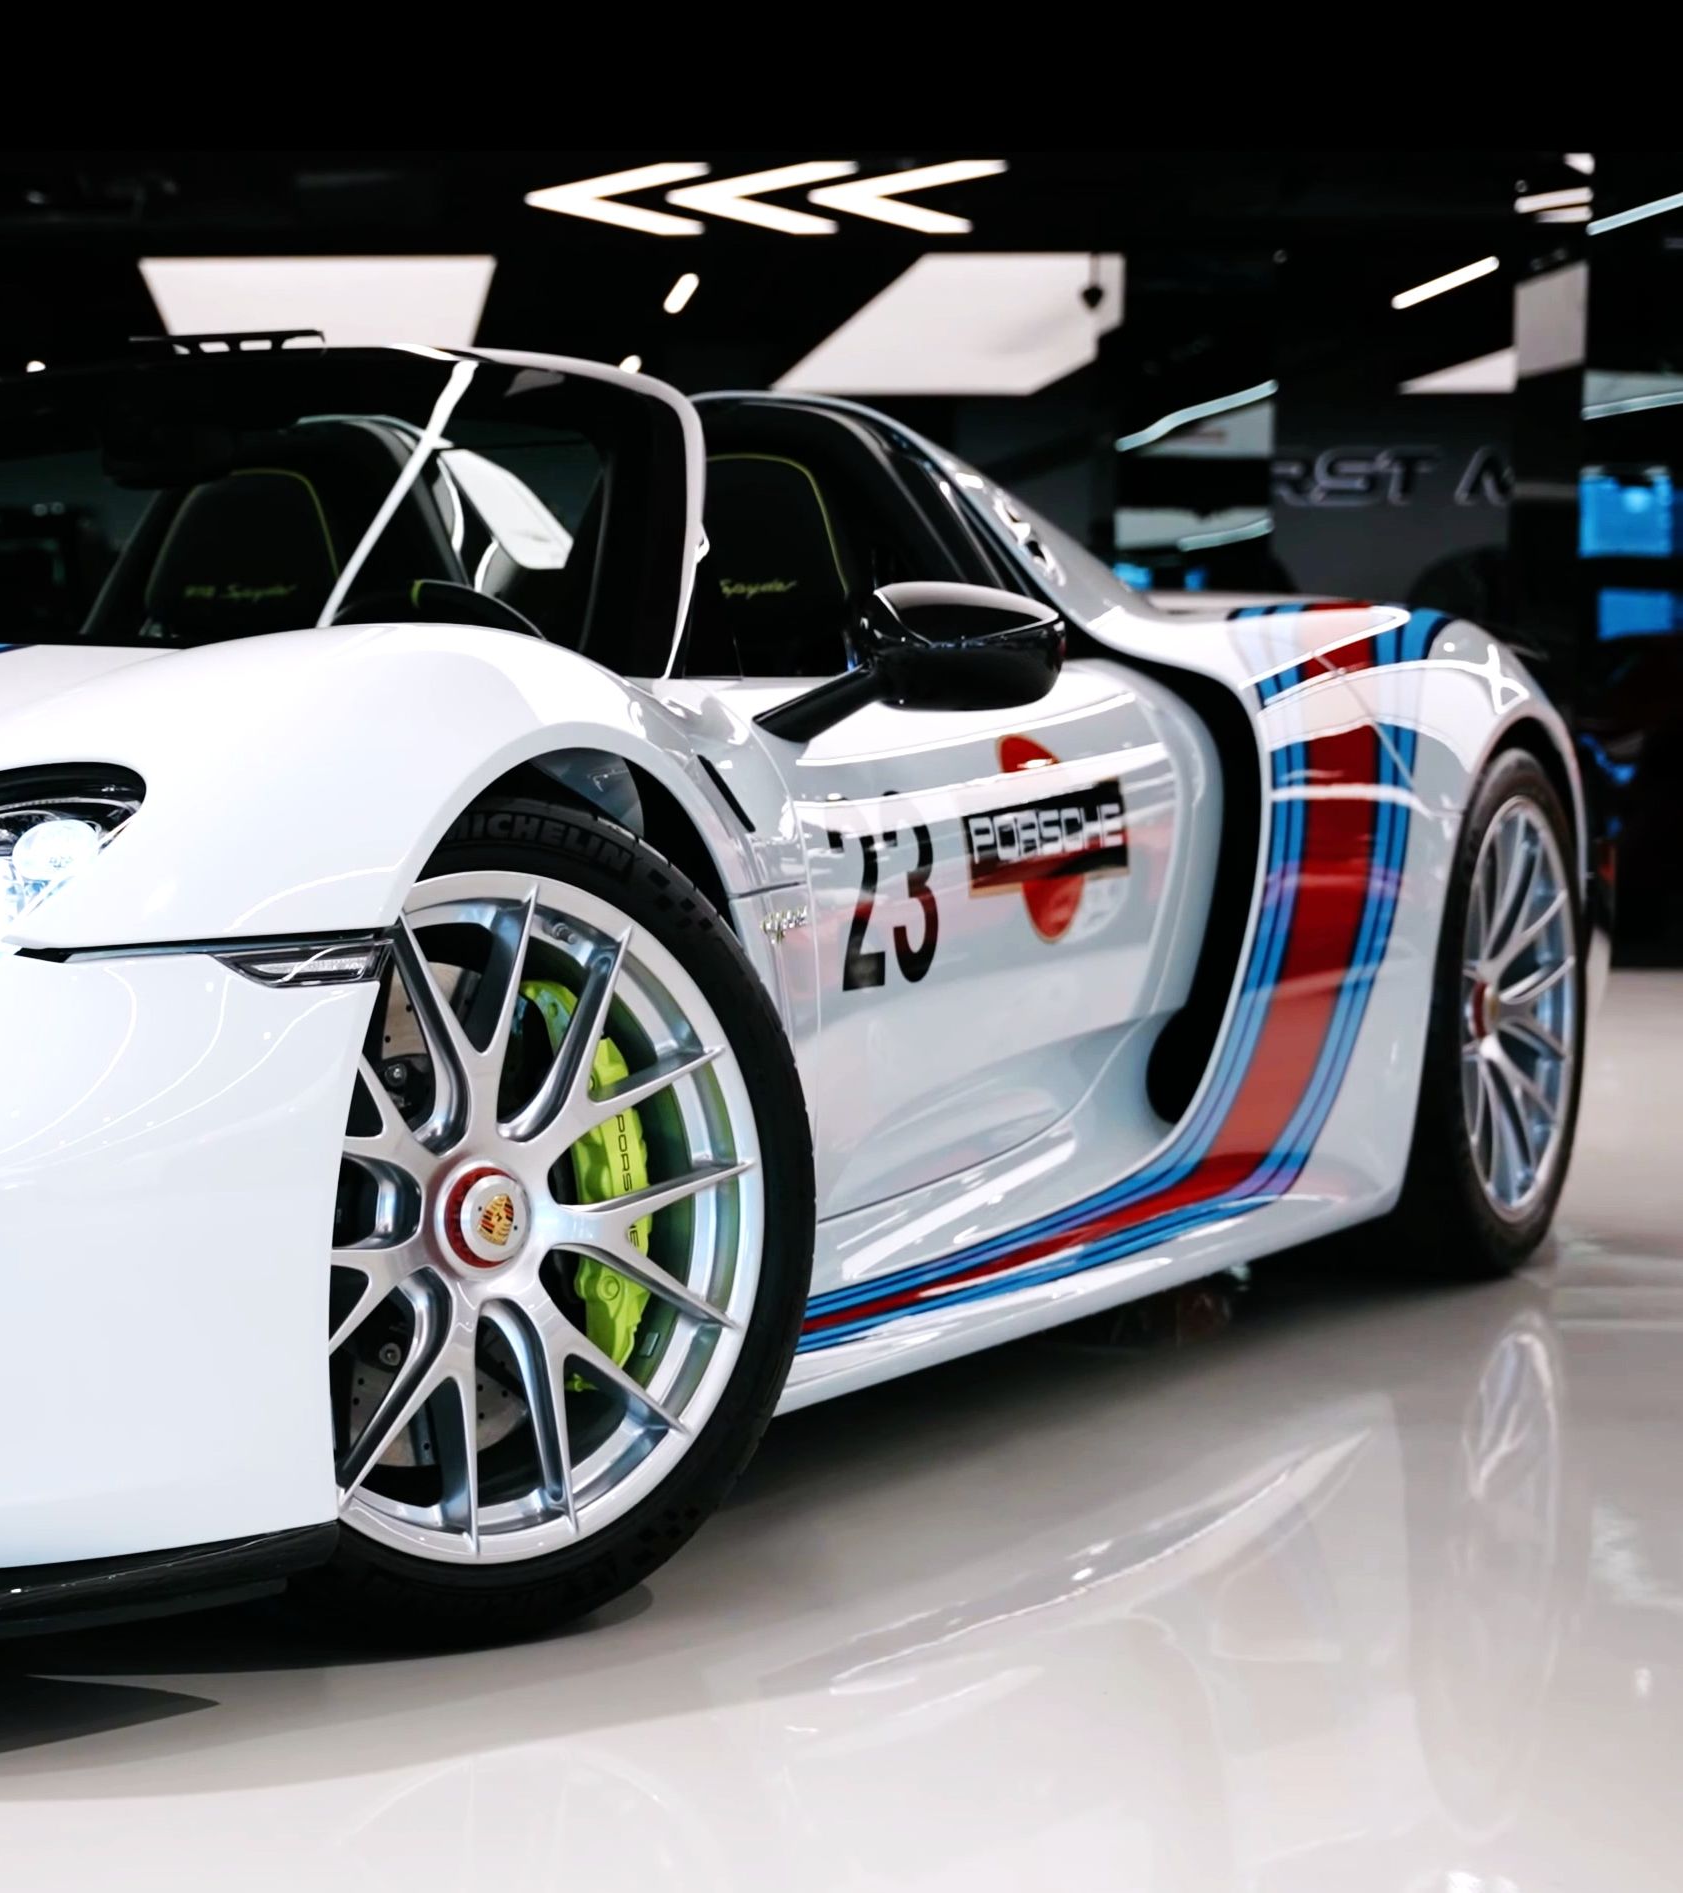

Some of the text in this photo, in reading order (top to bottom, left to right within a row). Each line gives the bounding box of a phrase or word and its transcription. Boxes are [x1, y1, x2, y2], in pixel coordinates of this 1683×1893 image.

[825, 790, 939, 992] 23
[968, 802, 1124, 865] PORSCHE
[616, 1113, 640, 1249] PORSE
